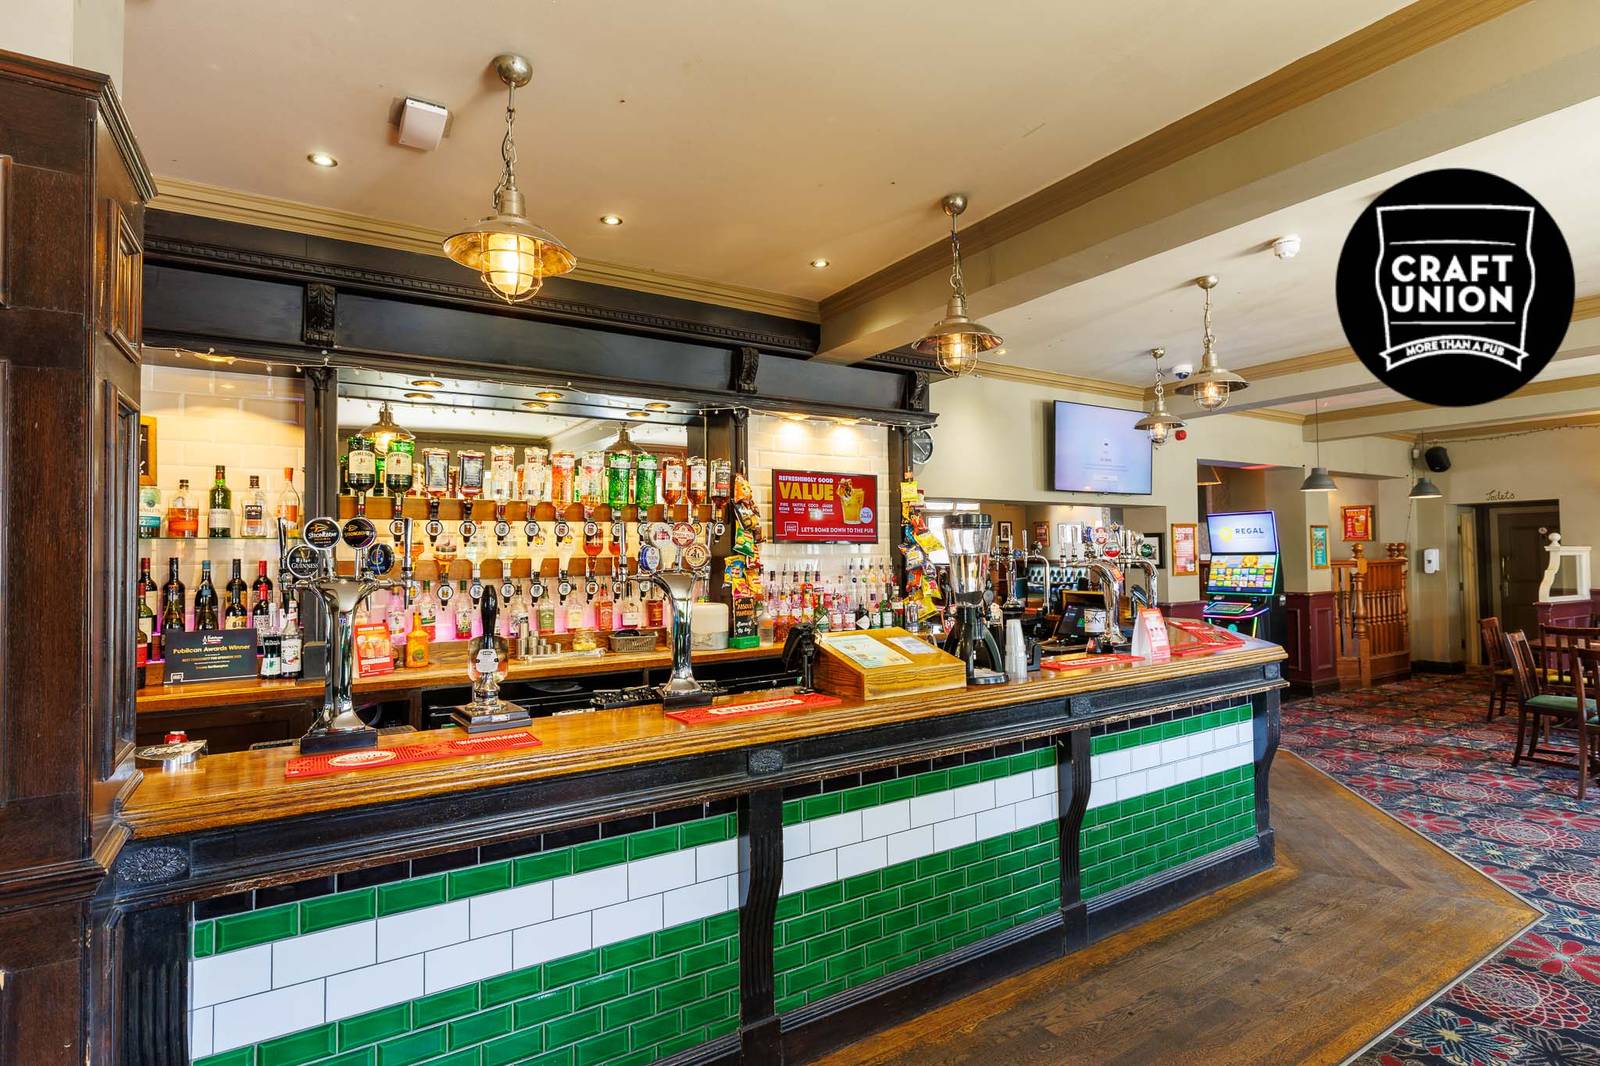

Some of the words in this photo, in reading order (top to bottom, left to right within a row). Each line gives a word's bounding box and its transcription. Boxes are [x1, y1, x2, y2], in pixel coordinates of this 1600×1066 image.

[778, 481, 834, 501] VALUE
[1235, 527, 1265, 535] REGAL
[203, 645, 229, 653] Awards
